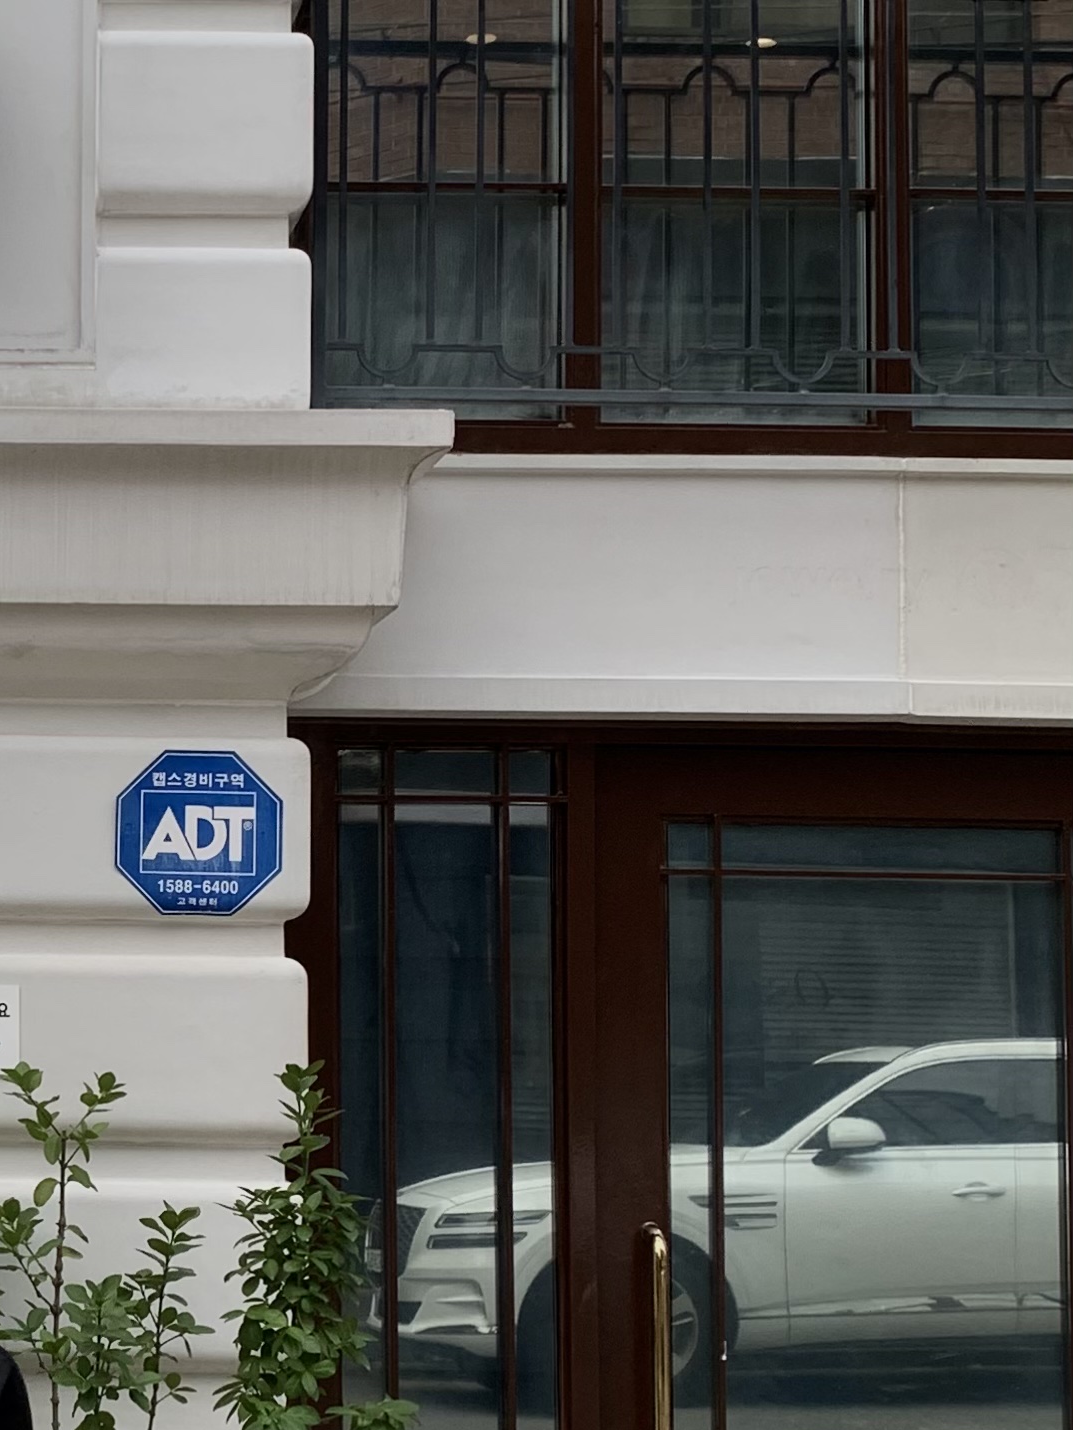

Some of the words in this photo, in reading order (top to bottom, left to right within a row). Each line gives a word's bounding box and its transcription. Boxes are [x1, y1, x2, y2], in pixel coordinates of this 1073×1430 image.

[152, 771, 245, 788] 캡스경비구역
[141, 804, 255, 862] ADT
[157, 879, 239, 895] 1588-6400
